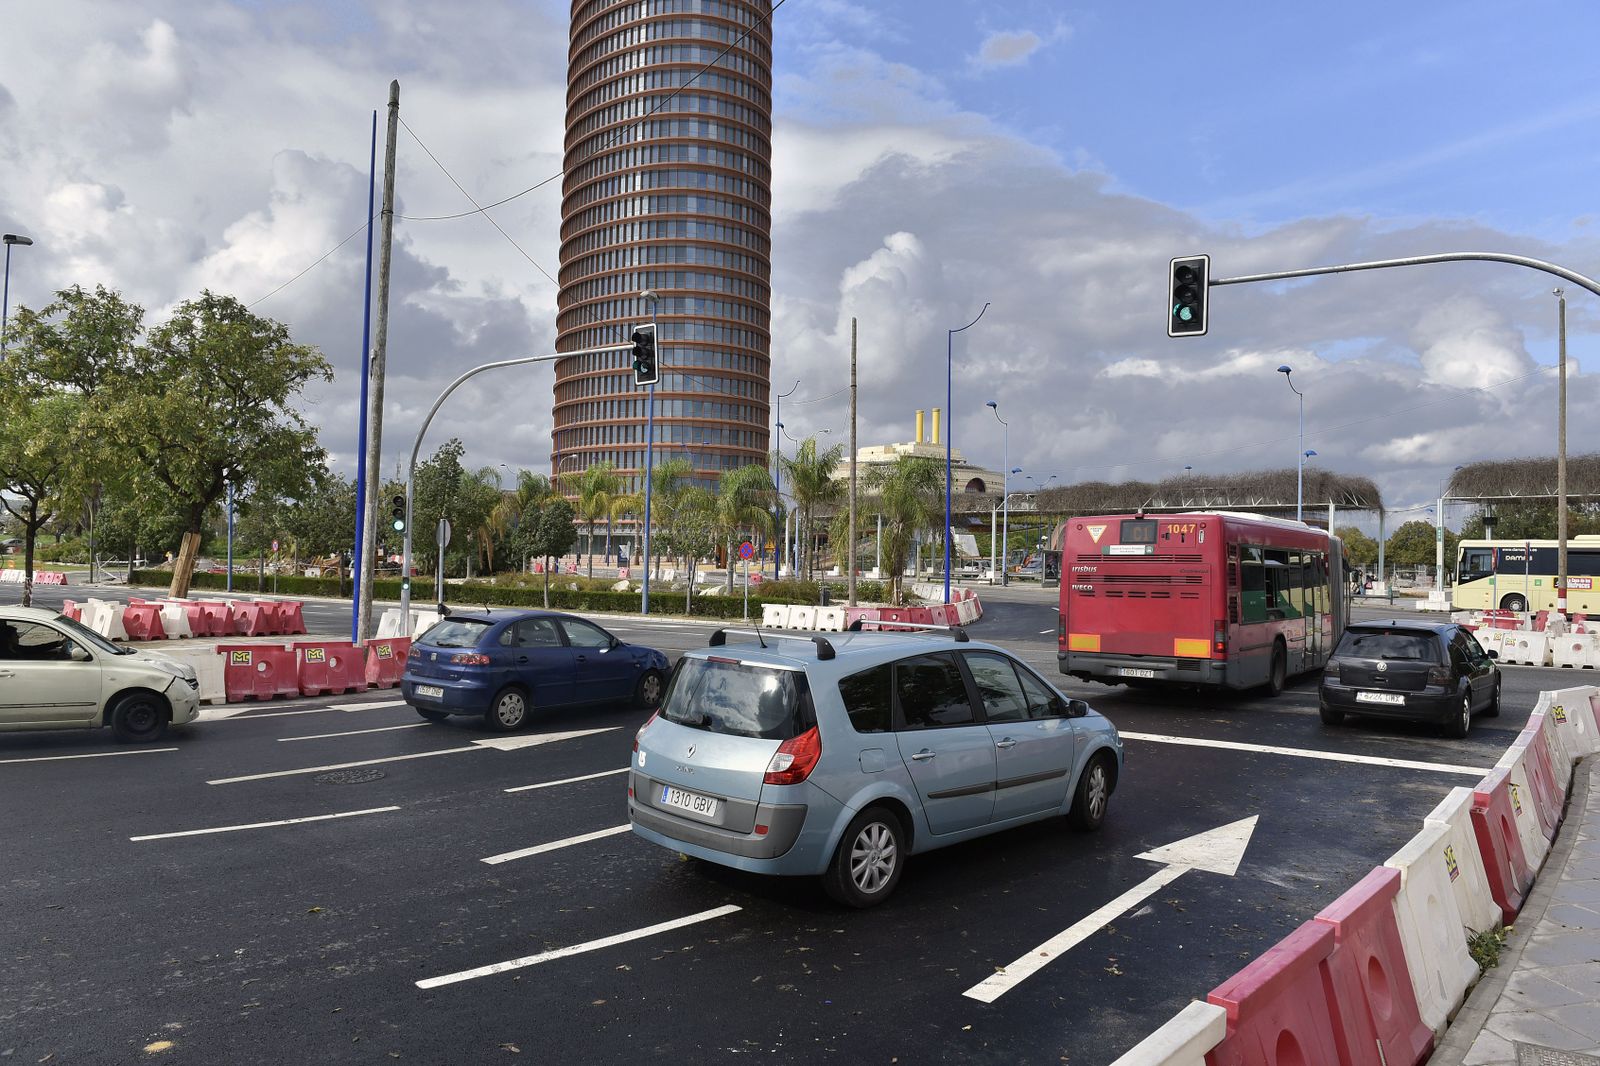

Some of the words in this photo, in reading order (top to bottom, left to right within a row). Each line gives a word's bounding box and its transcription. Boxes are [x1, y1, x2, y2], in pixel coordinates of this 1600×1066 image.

[1167, 524, 1196, 534] 1047
[671, 790, 691, 807] 1310
[693, 797, 713, 813] GBV
